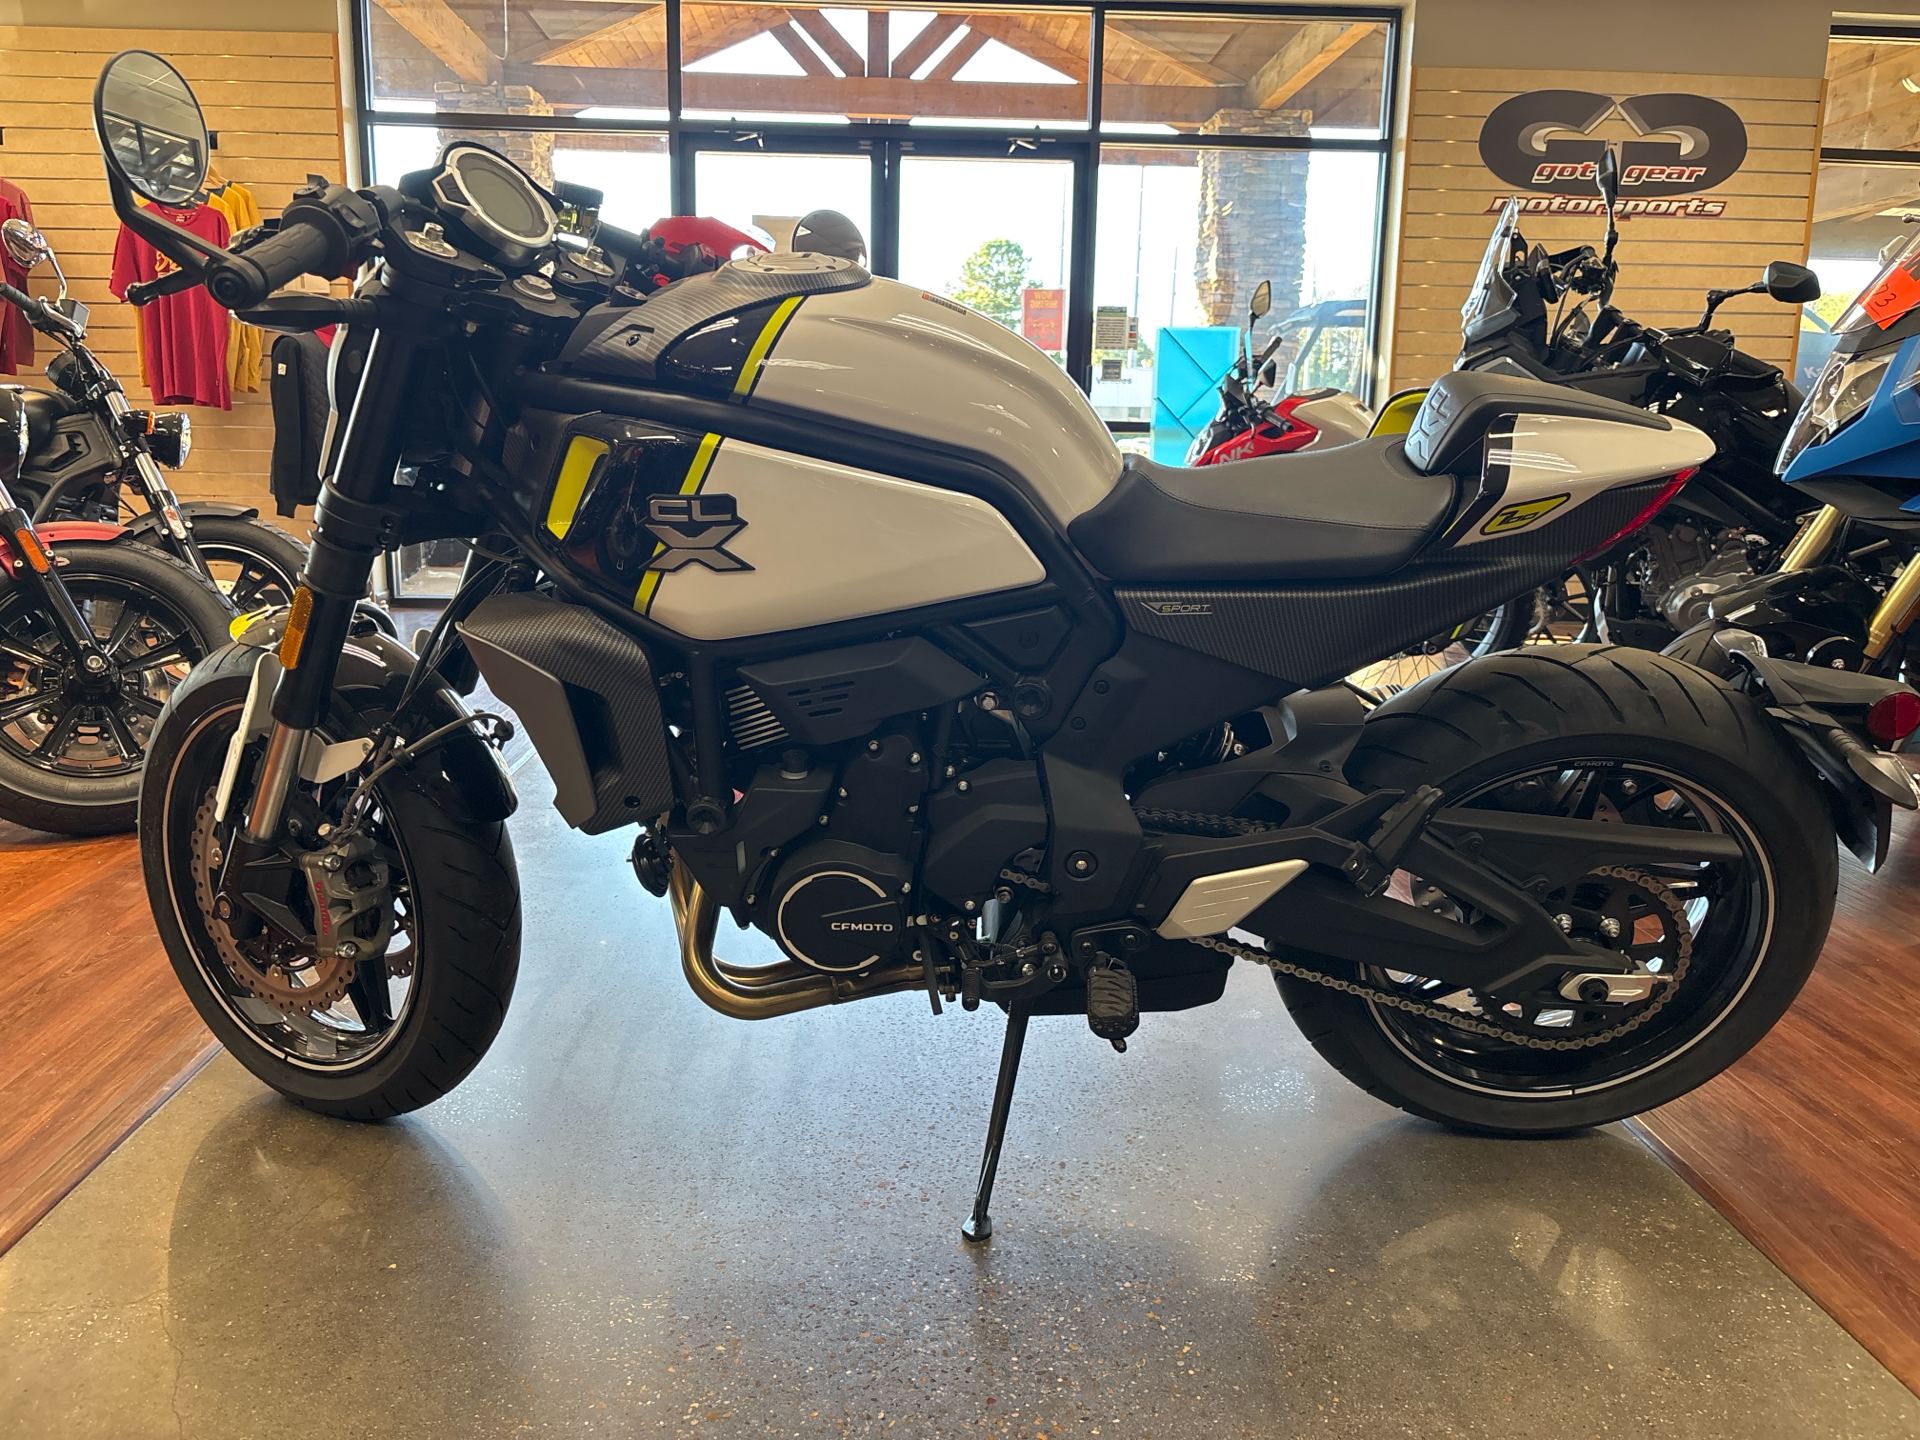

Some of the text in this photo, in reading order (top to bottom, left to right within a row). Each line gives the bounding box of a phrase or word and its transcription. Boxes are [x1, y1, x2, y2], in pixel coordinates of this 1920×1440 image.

[1531, 162, 1706, 186] got gear
[1488, 195, 1726, 220] motorsports
[1496, 510, 1541, 527] 700
[1160, 603, 1212, 614] SPORT
[830, 922, 894, 932] CFMOTO
